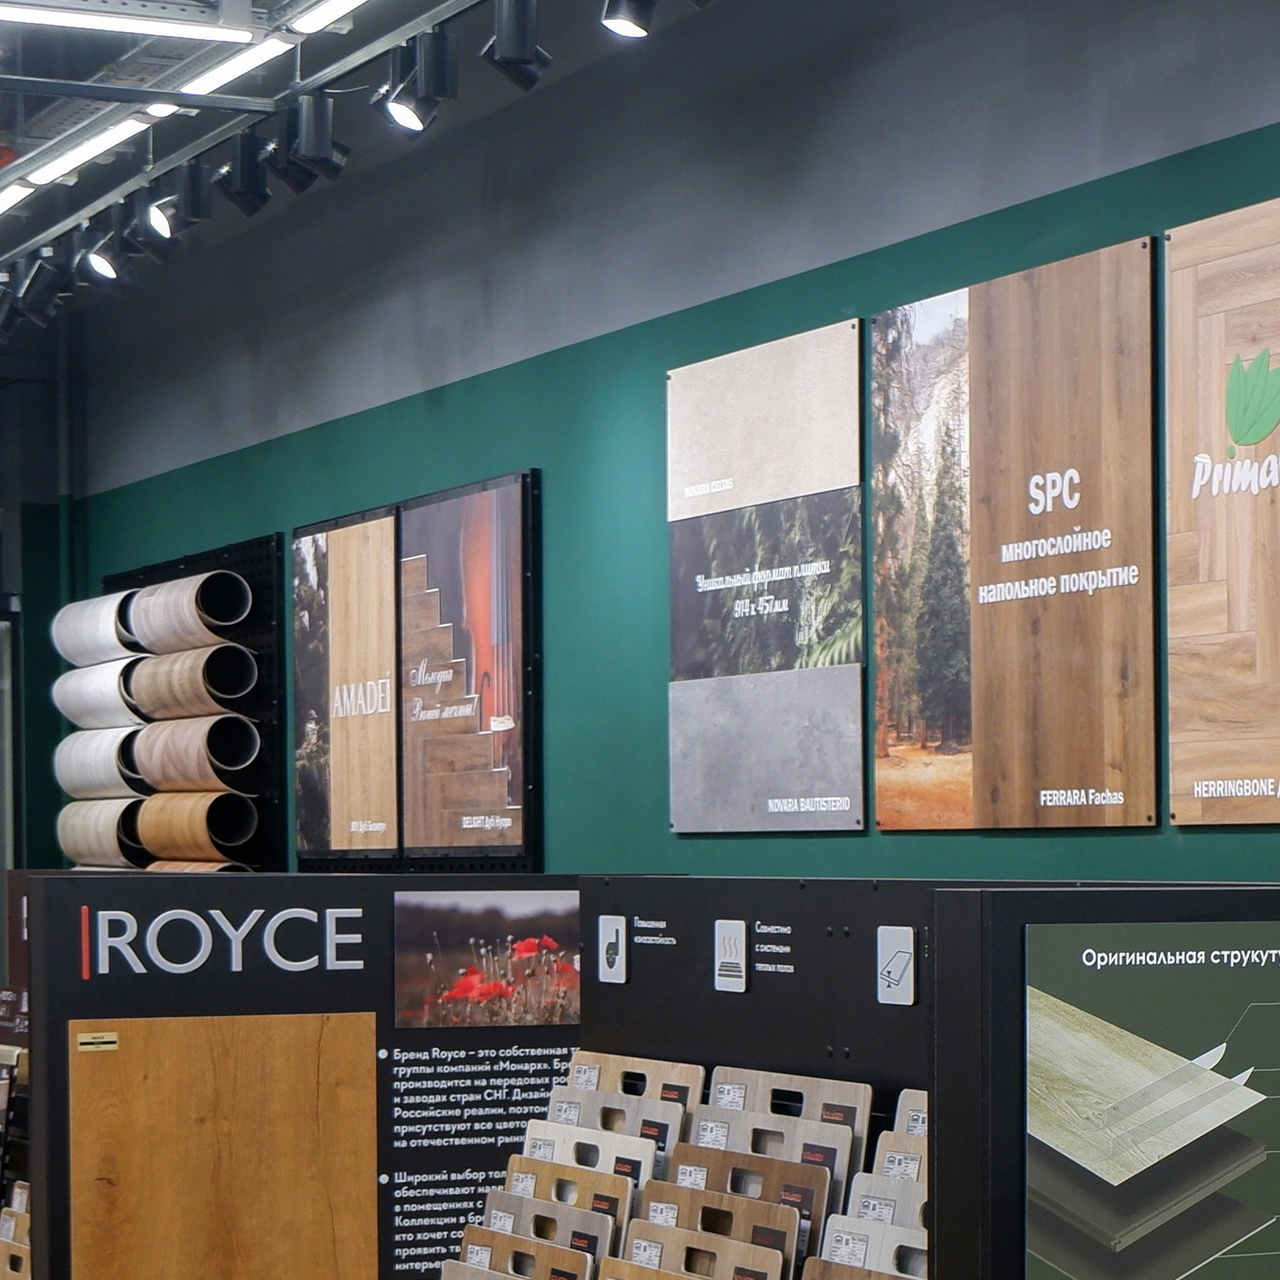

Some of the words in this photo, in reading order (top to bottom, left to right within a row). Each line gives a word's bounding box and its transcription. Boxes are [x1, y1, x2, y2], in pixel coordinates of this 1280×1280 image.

[1027, 468, 1081, 515] SPC
[1000, 526, 1112, 564] многослойное
[978, 575, 1057, 604] напольное
[1059, 564, 1139, 597] покрытие
[1040, 790, 1086, 806] FERRARA
[1088, 788, 1124, 806] Fachas
[1193, 776, 1276, 798] HERRINGBONE
[97, 908, 364, 974] ROYCE
[1082, 948, 1205, 970] Оригинальная
